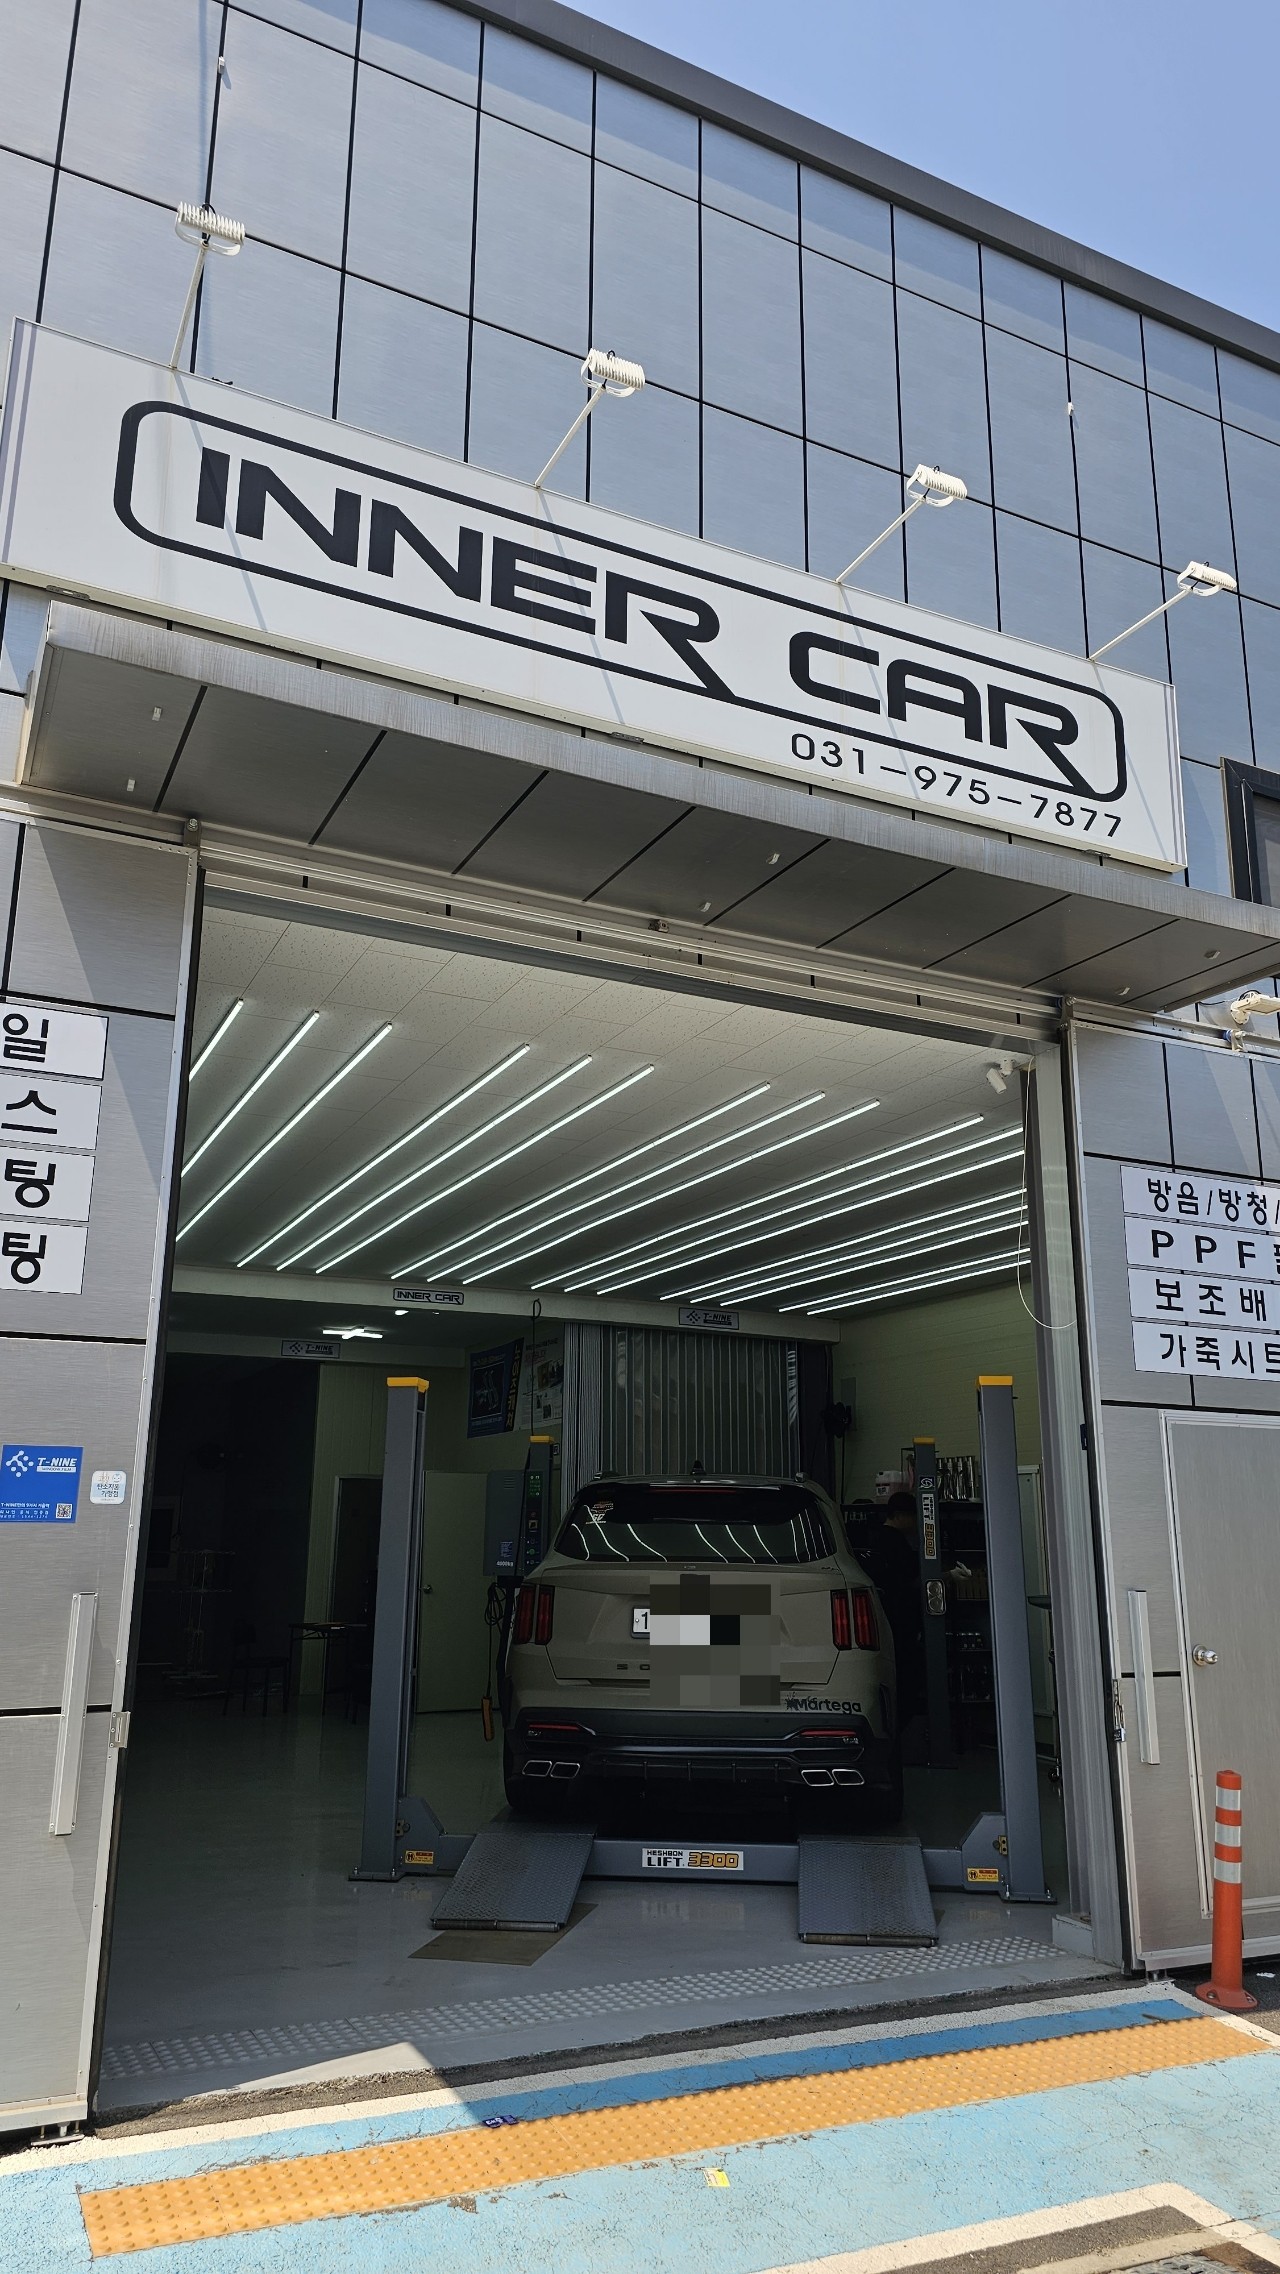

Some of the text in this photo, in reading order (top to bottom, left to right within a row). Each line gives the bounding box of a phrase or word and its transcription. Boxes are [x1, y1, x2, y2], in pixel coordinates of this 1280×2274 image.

[196, 447, 1105, 801] INNER CAR
[791, 733, 1122, 837] 031-975-7877
[2, 1013, 49, 1063] 일
[1, 1089, 57, 1134] 스
[4, 1158, 56, 1208] 팅
[1, 1231, 47, 1284] 팅
[397, 1290, 462, 1305] INNER CAR
[703, 1312, 732, 1322] T-NINE
[306, 1343, 333, 1352] T-NINE
[37, 1457, 77, 1467] T-NINE
[646, 1849, 684, 1857] HESHBON
[647, 1851, 739, 1868] LIFT 3300
